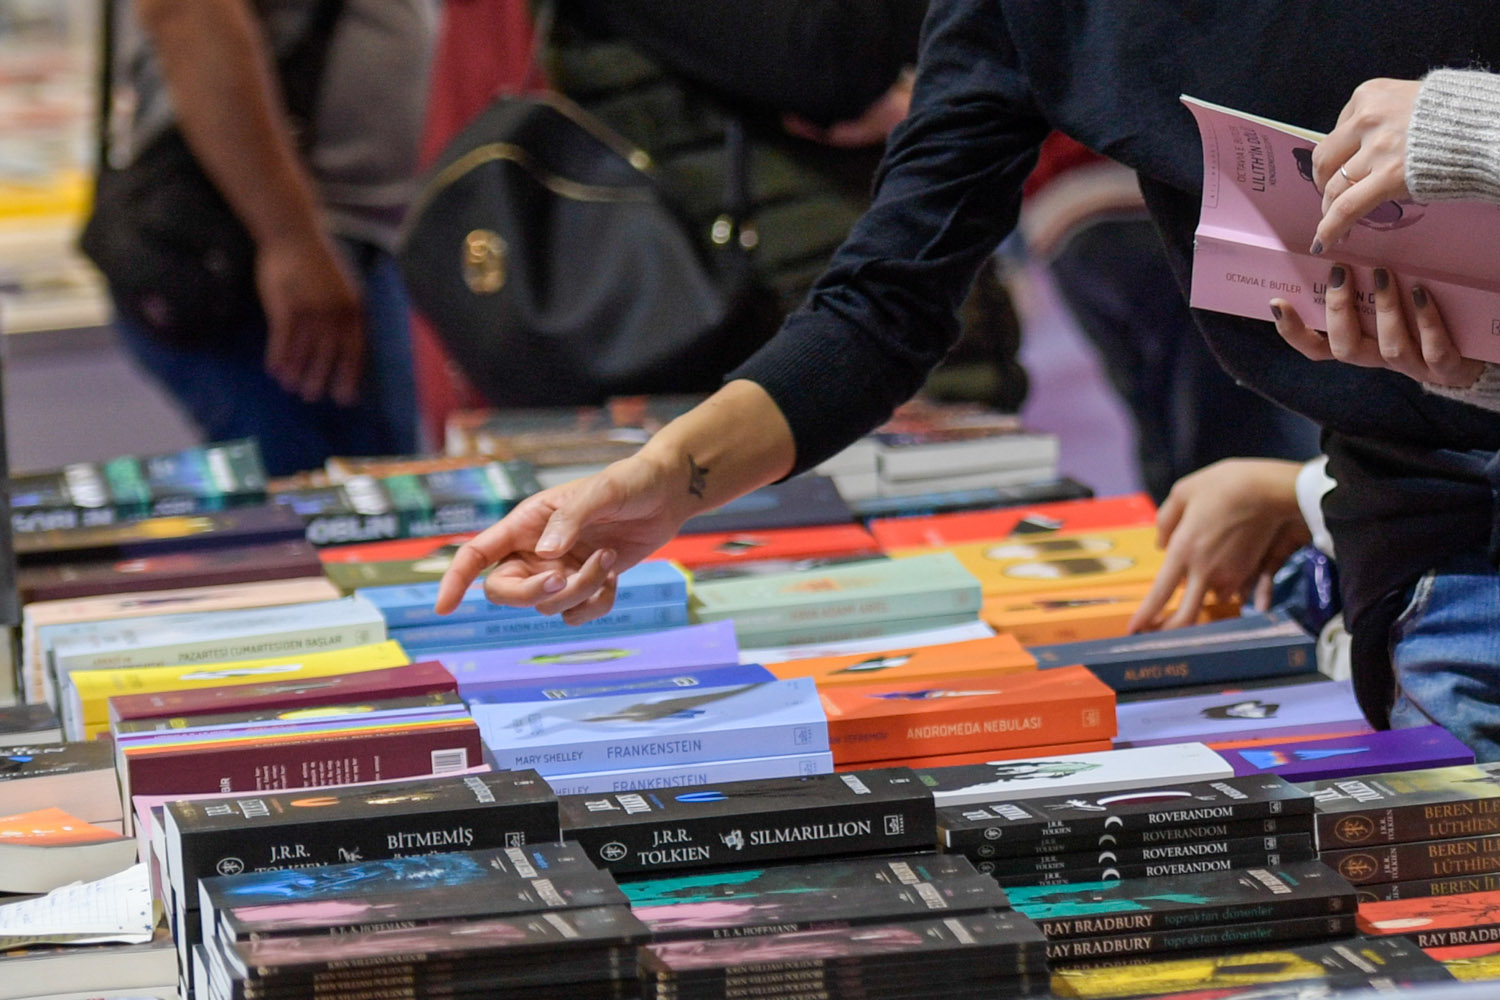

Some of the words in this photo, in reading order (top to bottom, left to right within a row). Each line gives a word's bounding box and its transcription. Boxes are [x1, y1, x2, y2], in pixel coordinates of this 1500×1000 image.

[1225, 272, 1260, 287] OCTAVIA
[1269, 280, 1302, 295] BUTLER
[906, 721, 981, 739] ANDROMEDA
[983, 716, 1042, 733] NEBULASI
[515, 753, 541, 765] MARY
[542, 750, 584, 764] SHELLEY
[606, 740, 702, 759] FRANKENSTEIN
[612, 773, 708, 792] FRANKENSTEIN
[1148, 807, 1233, 824] ROVERANDOM
[1424, 802, 1474, 819] BEREN
[749, 820, 872, 846] SILMARILLION
[1041, 826, 1072, 836] TOLKIEN
[1142, 825, 1228, 842] ROVERANDOM
[1386, 809, 1395, 841] TOLKIEN
[386, 826, 474, 850] BİTMEMİŞ
[652, 828, 692, 847] J.R.R.
[270, 844, 311, 863] J.R.R.
[637, 846, 711, 866] TOLKIEN
[1142, 842, 1228, 860] ROVERANDOM
[1428, 840, 1478, 858] BEREN
[1035, 862, 1065, 871] TOLKIEN
[1146, 860, 1231, 878] ROVERANDOM
[1430, 879, 1480, 896] BEREN
[743, 923, 798, 936] HOFFMANN
[1042, 920, 1072, 936] RAY
[1074, 914, 1153, 933] BRADBURY
[1073, 936, 1152, 955] BRADBURY
[1418, 932, 1447, 948] RAY
